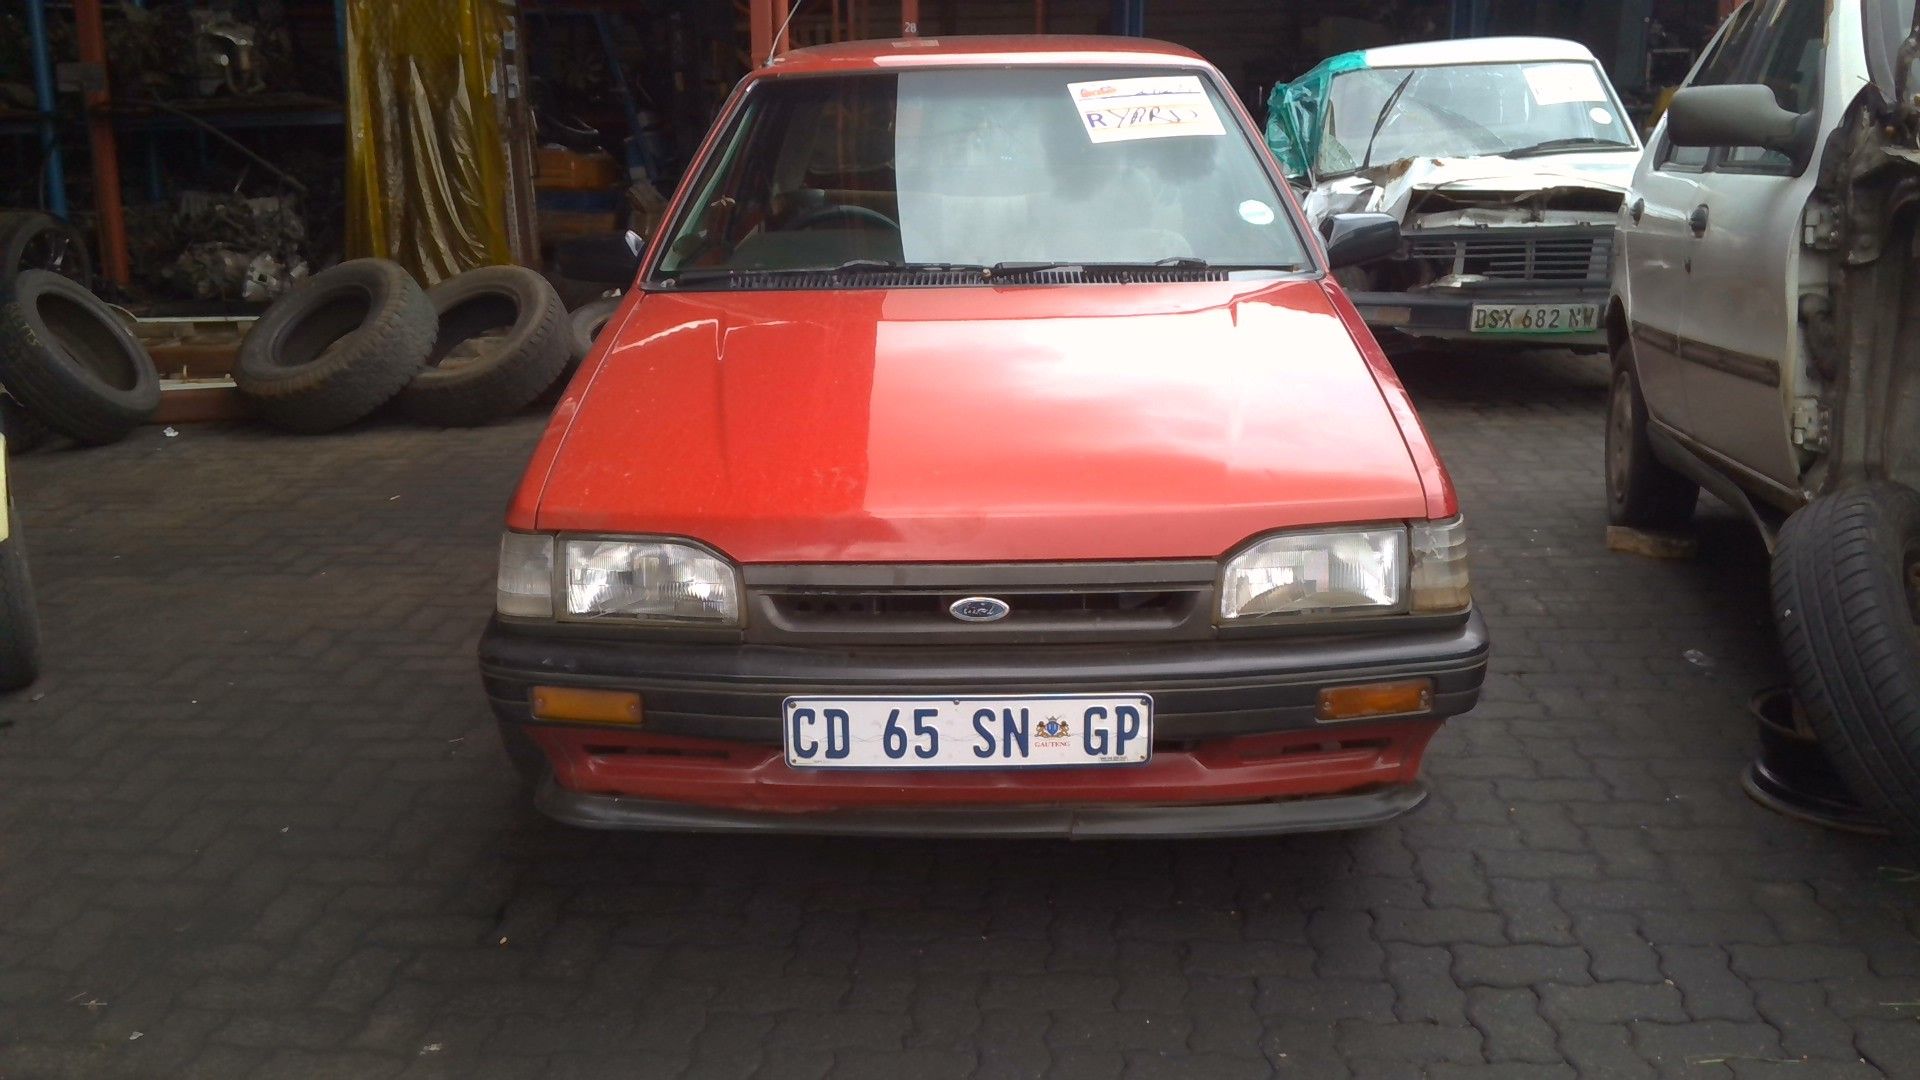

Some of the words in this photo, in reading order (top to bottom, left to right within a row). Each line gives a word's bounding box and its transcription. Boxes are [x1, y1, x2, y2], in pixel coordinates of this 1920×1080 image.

[904, 21, 917, 33] 28
[1475, 308, 1515, 329] DSX
[1521, 308, 1560, 329] 682
[1568, 307, 1595, 329] NW
[792, 707, 850, 760] CD
[882, 707, 939, 760] 65
[972, 707, 1030, 760] SN
[1083, 705, 1141, 757] GP
